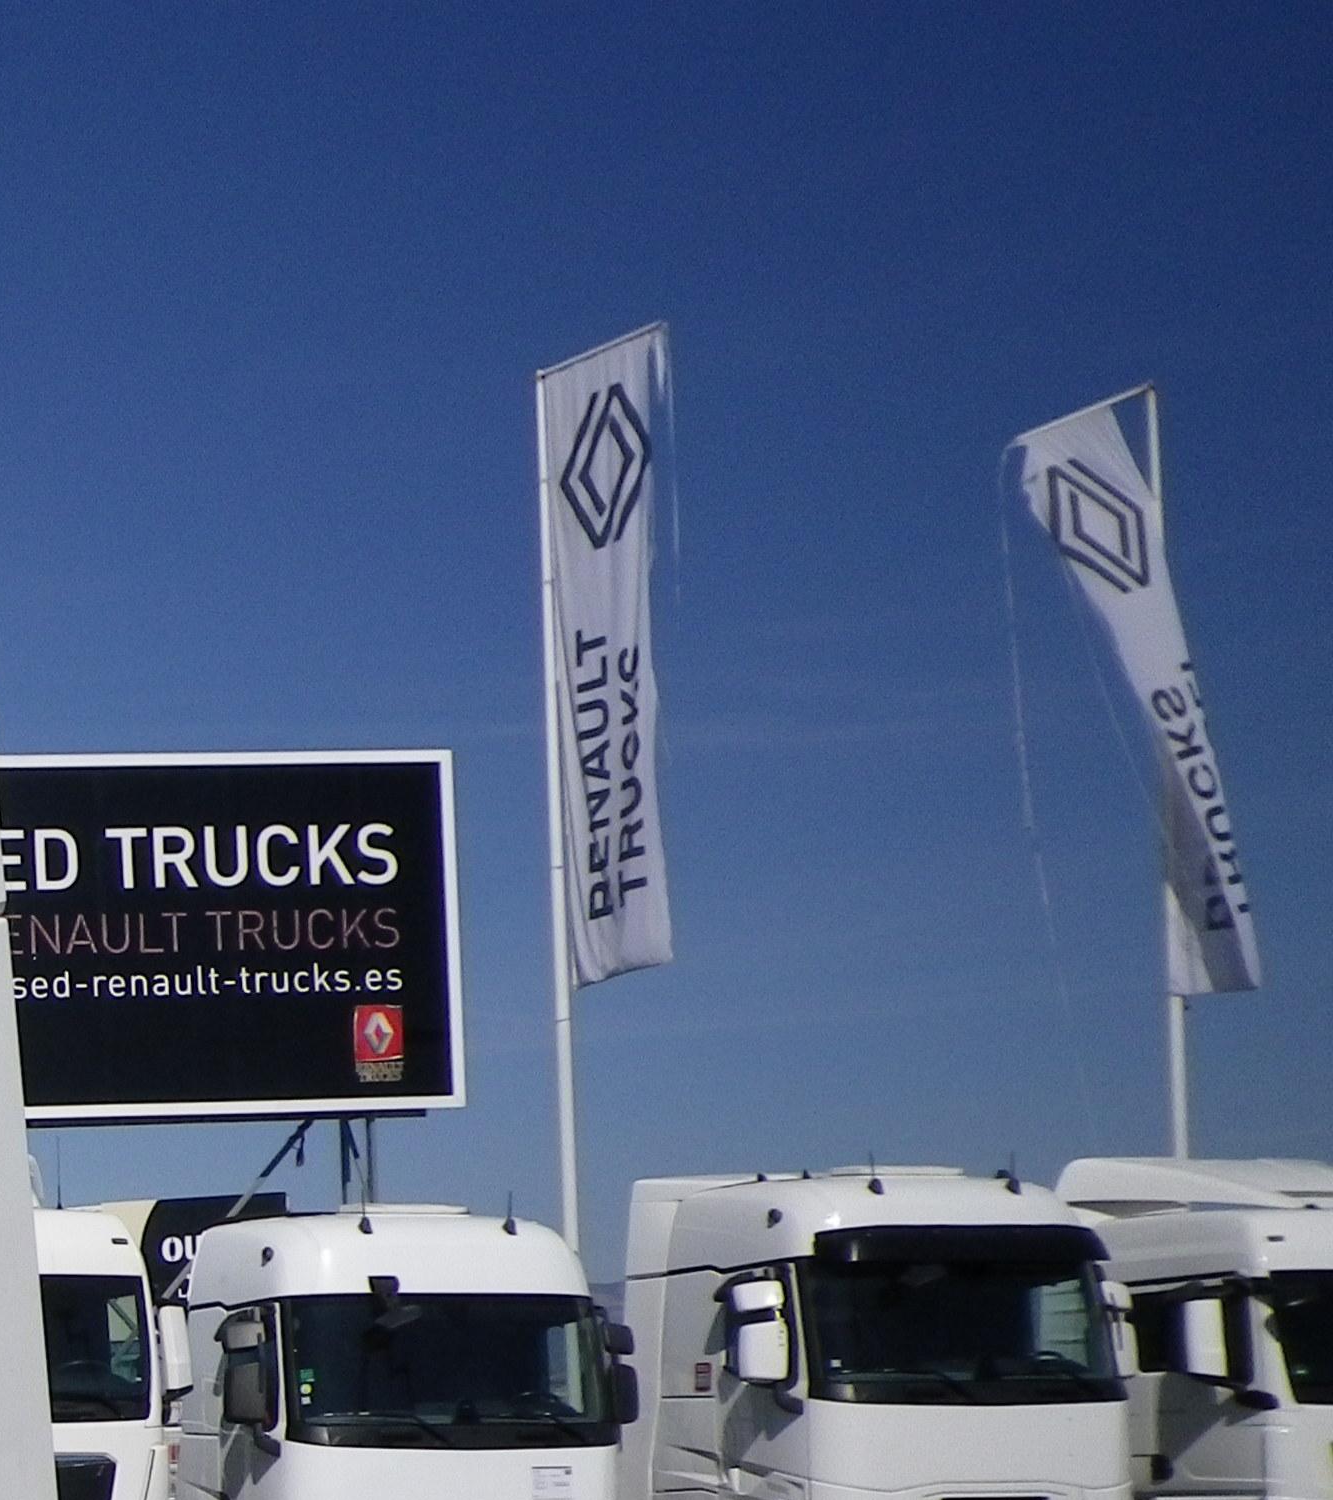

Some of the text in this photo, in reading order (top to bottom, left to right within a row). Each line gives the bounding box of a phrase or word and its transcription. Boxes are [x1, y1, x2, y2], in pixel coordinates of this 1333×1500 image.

[104, 822, 400, 890] TRUCKS
[575, 629, 614, 921] RENAULT
[617, 644, 649, 909] TRUCKS
[204, 907, 401, 952] TRUCKS
